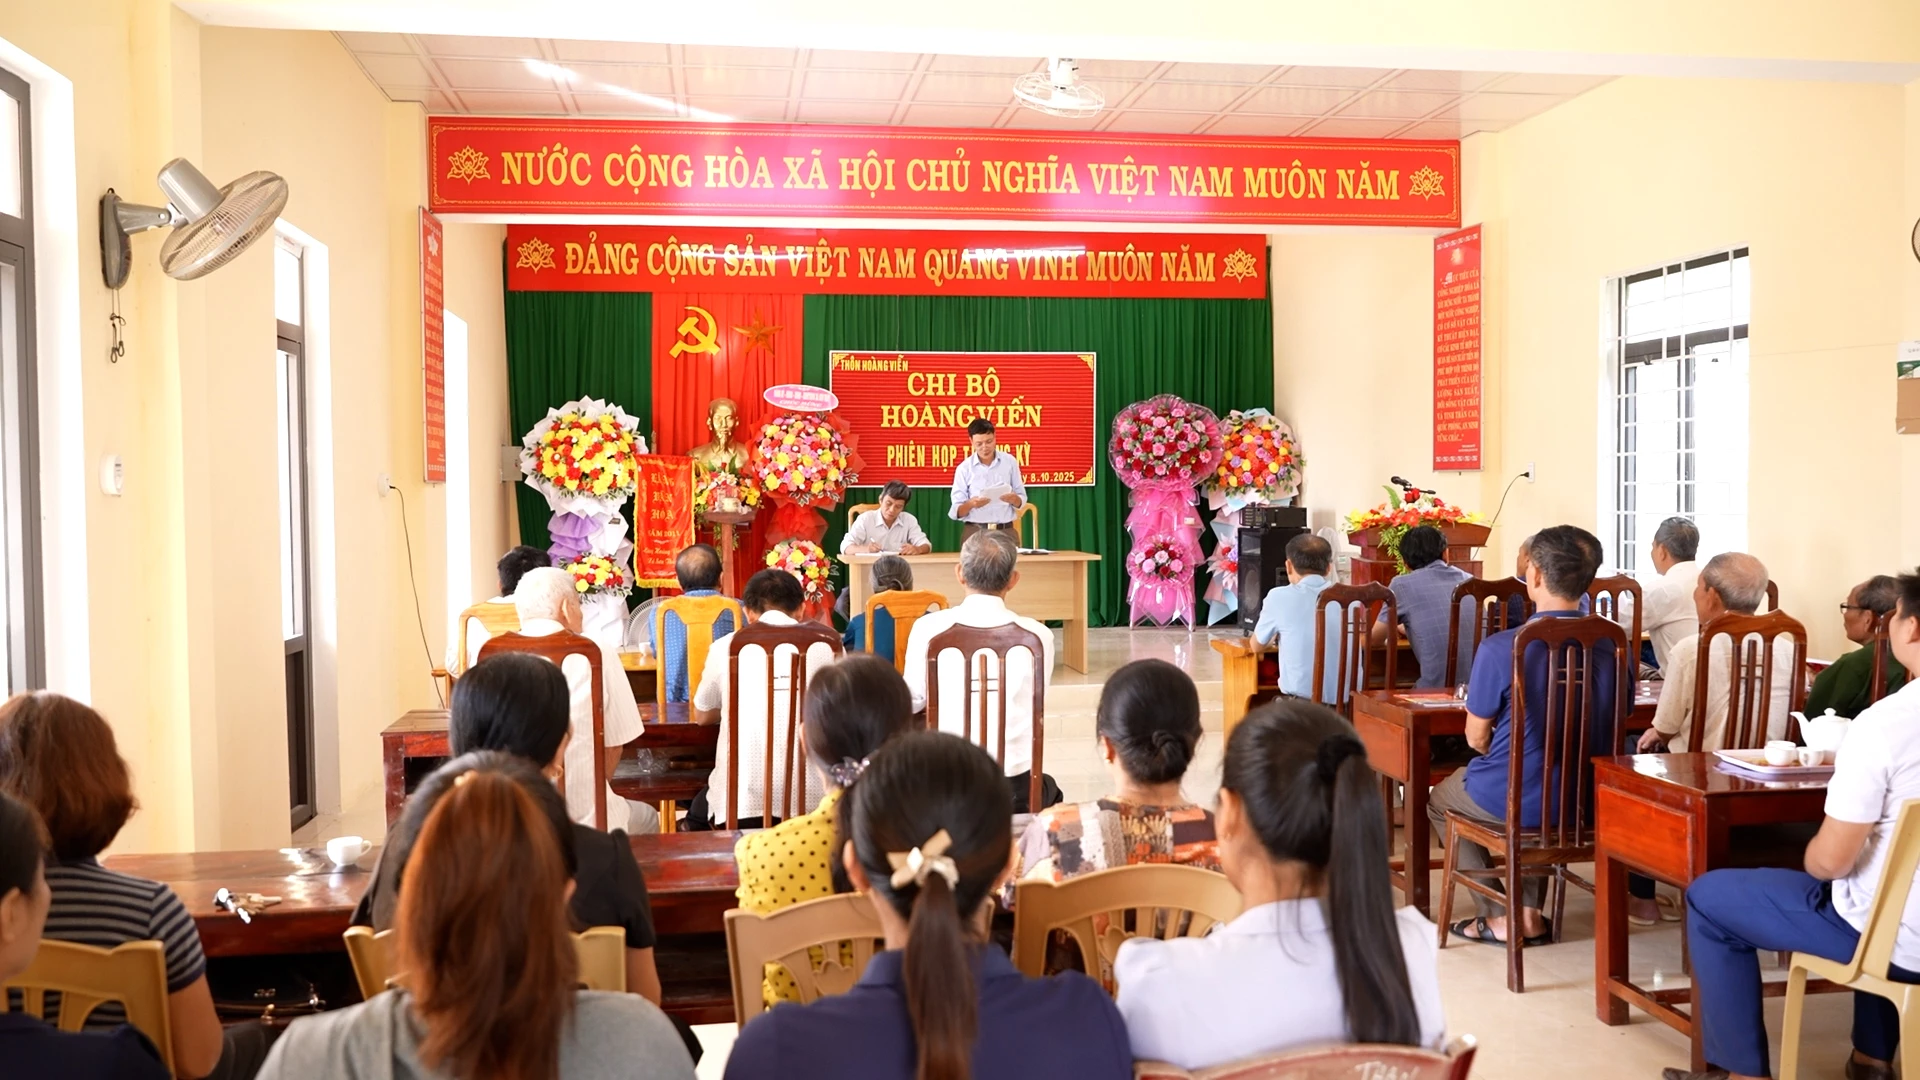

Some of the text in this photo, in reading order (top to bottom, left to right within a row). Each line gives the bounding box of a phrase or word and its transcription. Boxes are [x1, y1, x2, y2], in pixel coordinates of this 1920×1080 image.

[501, 142, 1400, 202] NƯỚC CỘNG HÒA XÃ HỘI CHỦ NGHĨA VIỆT NAM MUÔN NĂM
[565, 231, 1216, 287] ĐẢNG CỘNG SẢN VIỆT NAM QUANG VINH MUÔN NĂM
[841, 354, 908, 371] THÔN HOÀNG VIỄN
[907, 367, 1000, 403] CHI BỘ
[881, 395, 1042, 427] HOÀNG VIỄN
[887, 440, 925, 467] PHIÊN
[932, 445, 957, 472] HỌP
[1016, 441, 1031, 466] KỲ
[1030, 472, 1074, 482] 8.10.2025
